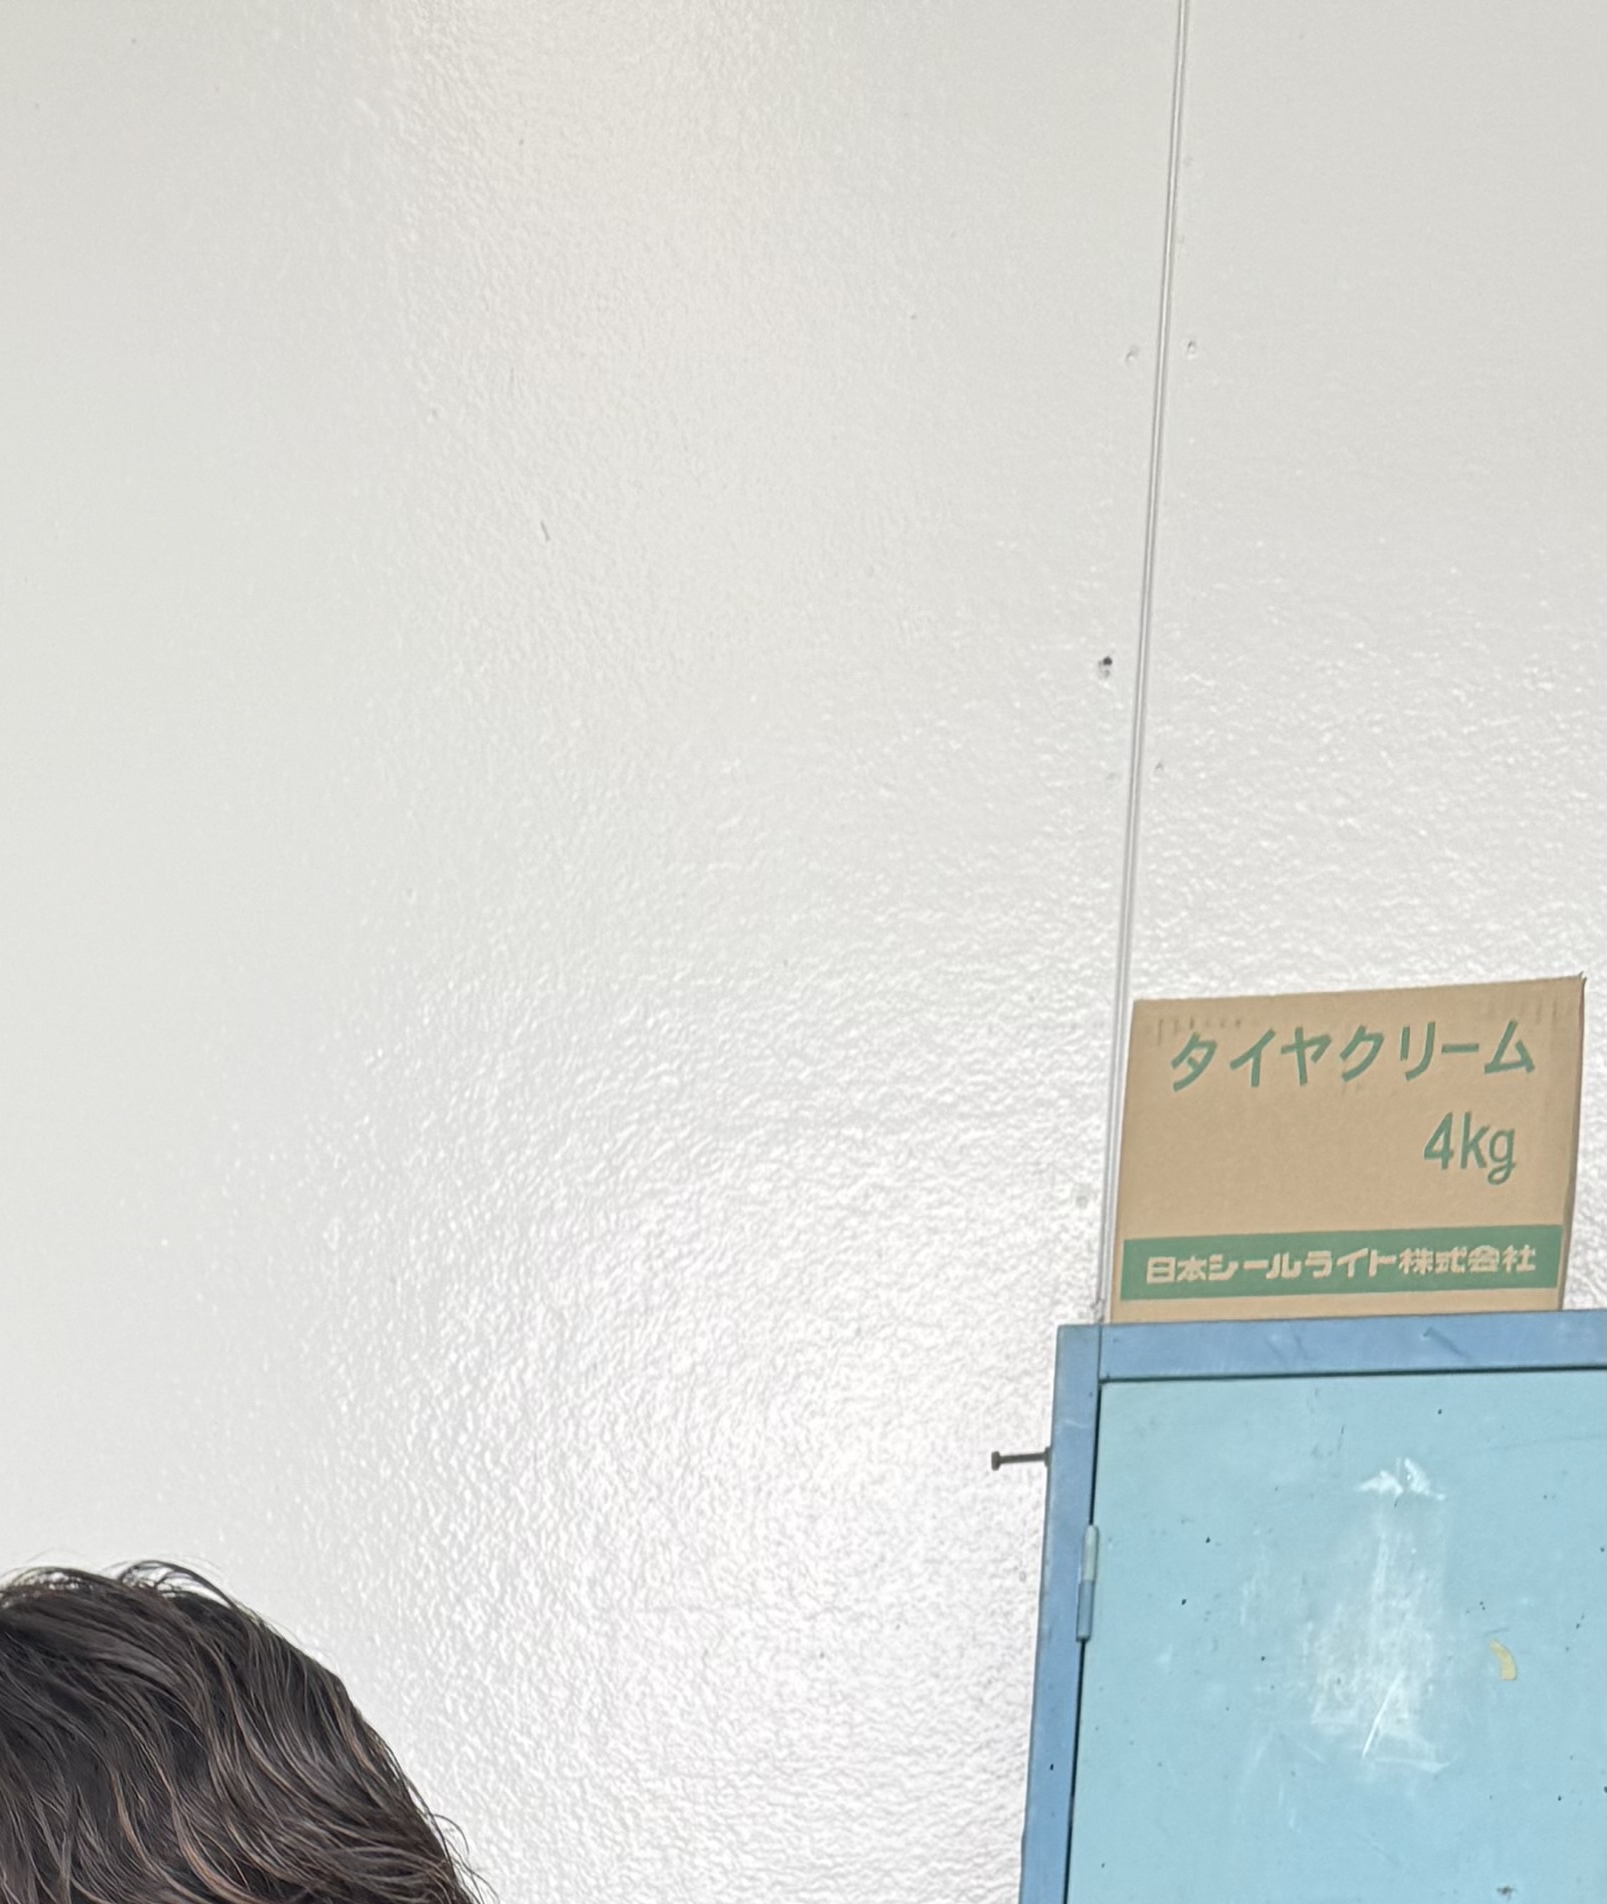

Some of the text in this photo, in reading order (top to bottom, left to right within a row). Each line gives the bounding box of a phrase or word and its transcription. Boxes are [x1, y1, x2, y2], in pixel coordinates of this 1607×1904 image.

[1170, 1020, 1536, 1092] タイヤクリーム
[1423, 1112, 1516, 1185] 4kg
[1145, 1244, 1537, 1285] 日本シールライト株式会社
